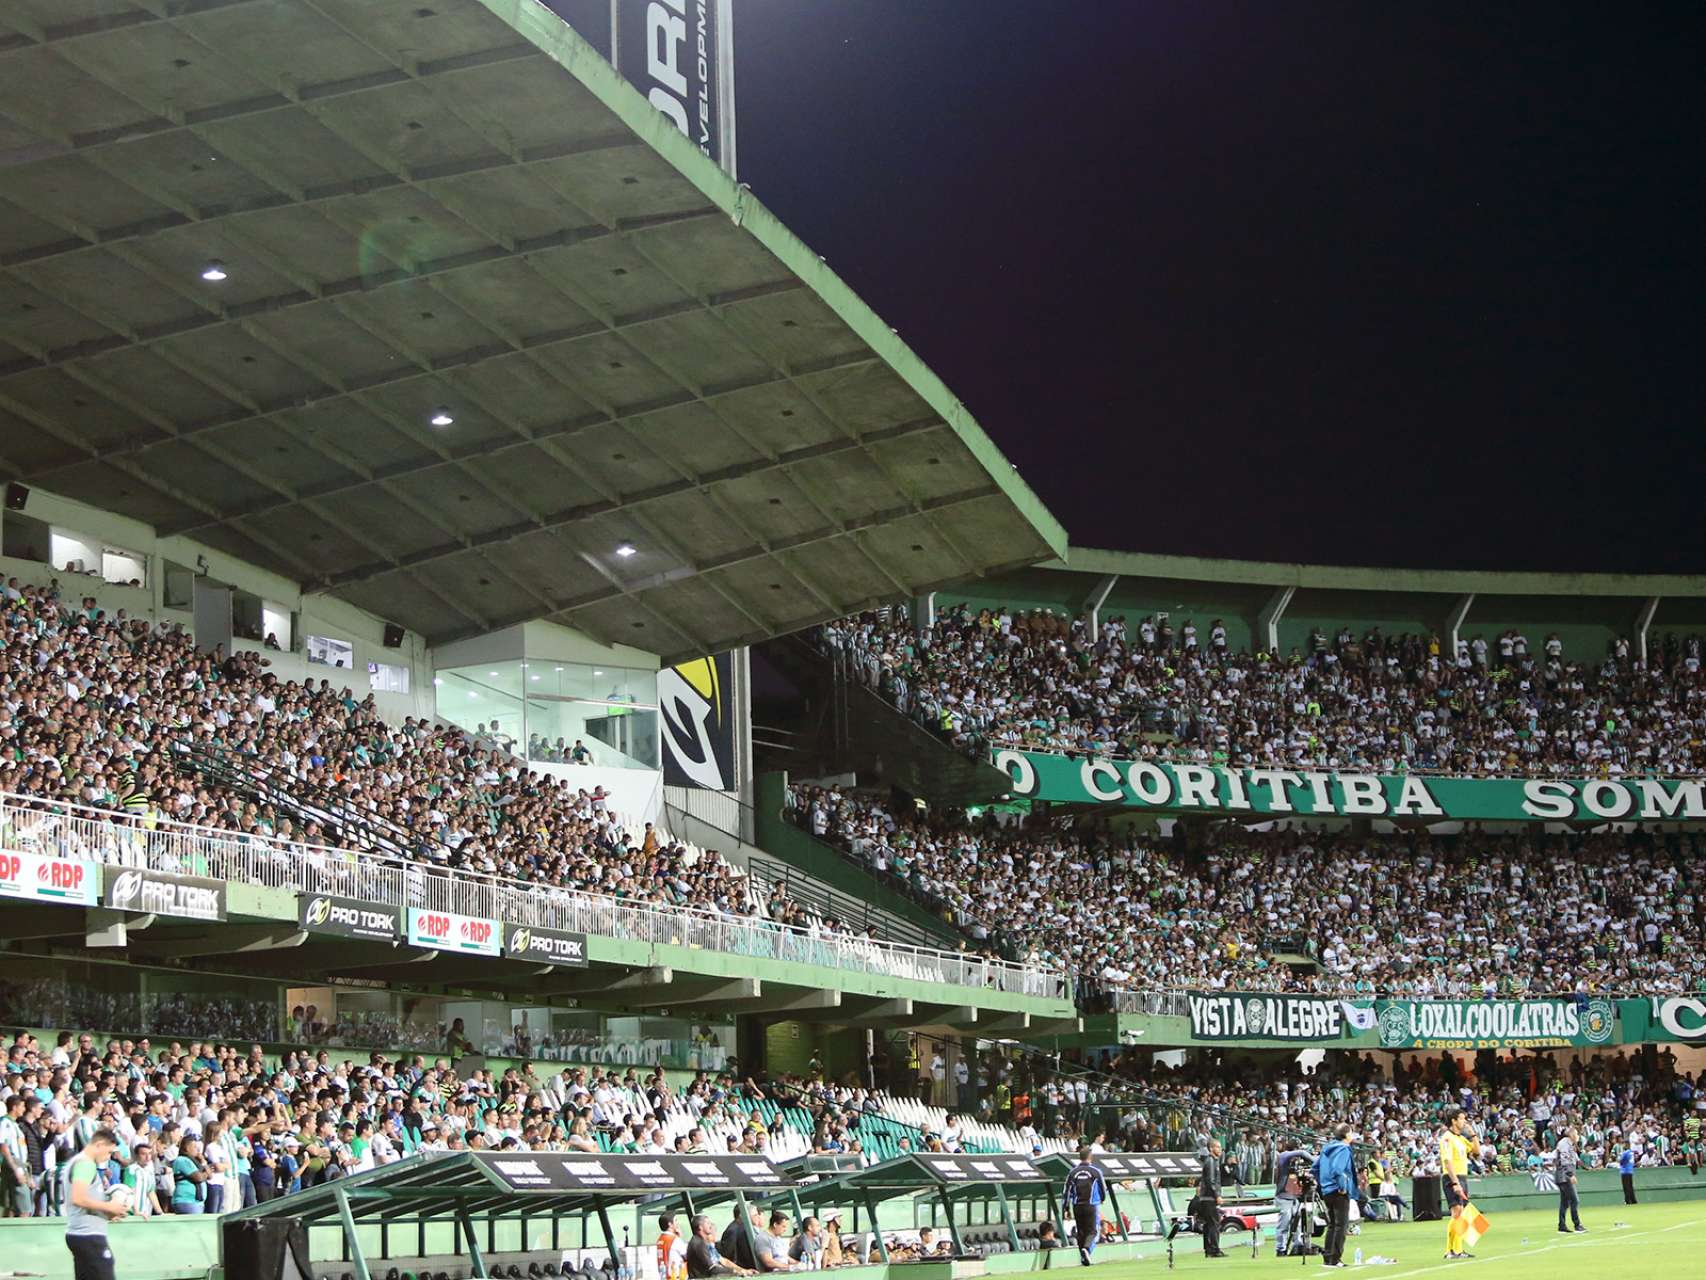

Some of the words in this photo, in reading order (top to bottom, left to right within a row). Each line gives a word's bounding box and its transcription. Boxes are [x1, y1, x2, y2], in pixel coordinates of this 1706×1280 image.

[697, 0, 710, 157] VELOPM
[1080, 761, 1443, 816] CORITIBA
[1521, 780, 1706, 818] SOM
[51, 862, 83, 889] RDP
[142, 880, 176, 903] PRO
[177, 885, 219, 908] TORK
[330, 906, 359, 925] PRO
[360, 911, 395, 930] TORK
[427, 914, 450, 937] RDP
[470, 921, 492, 943] RDP
[530, 935, 553, 952] PRO
[554, 939, 582, 957] TORK
[1189, 996, 1247, 1036] VISTA
[1263, 998, 1341, 1036] ALEGRE
[1660, 997, 1706, 1037] C
[1478, 1040, 1500, 1048] DO
[1504, 1037, 1573, 1047] CORITIBA
